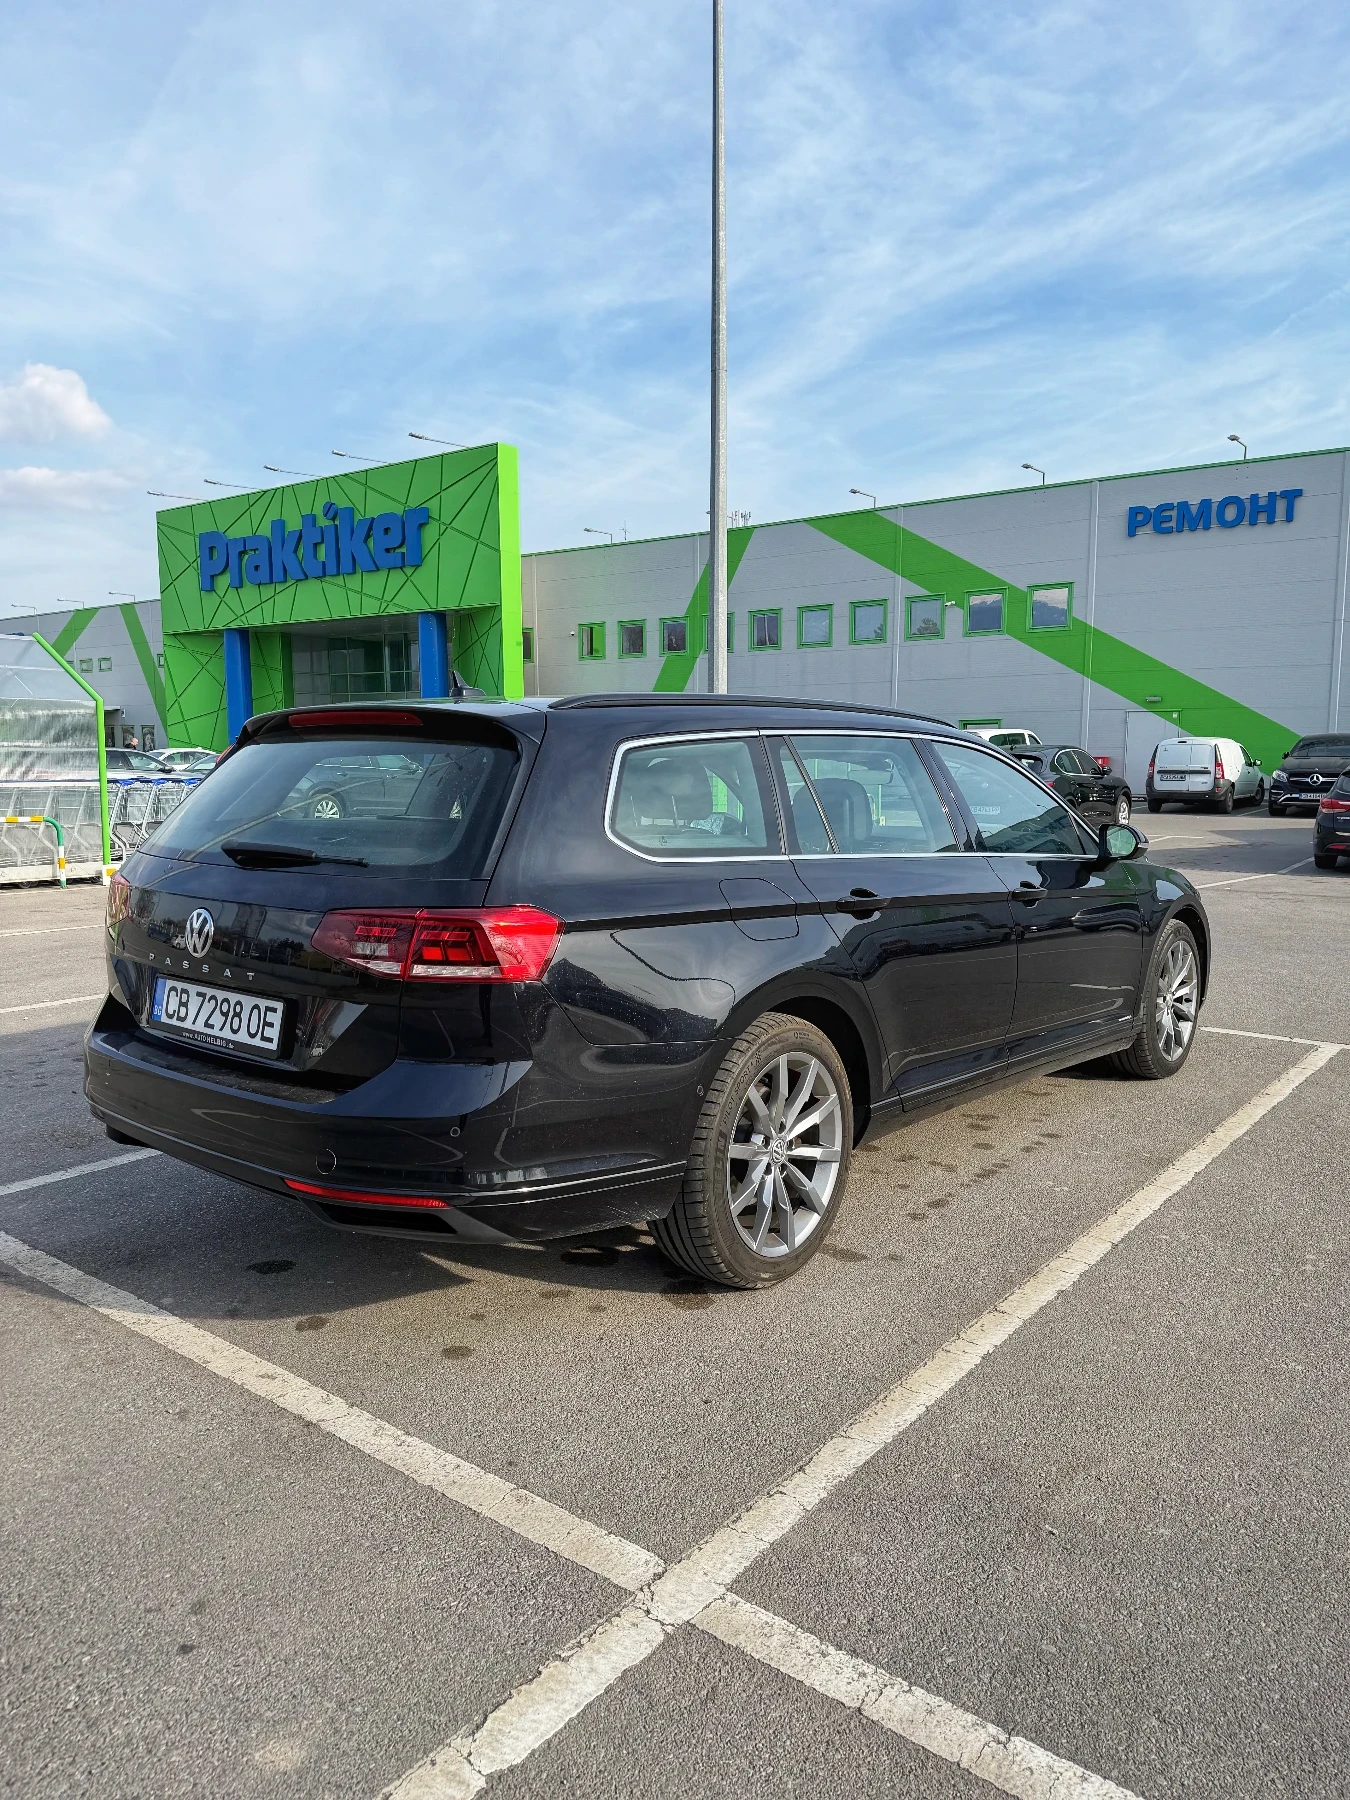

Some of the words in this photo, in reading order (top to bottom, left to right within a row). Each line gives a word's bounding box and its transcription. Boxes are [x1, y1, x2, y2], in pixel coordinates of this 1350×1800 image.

[1127, 489, 1303, 537] РЕМОНТ
[199, 501, 429, 592] Praktiker
[149, 953, 255, 981] PASSAT
